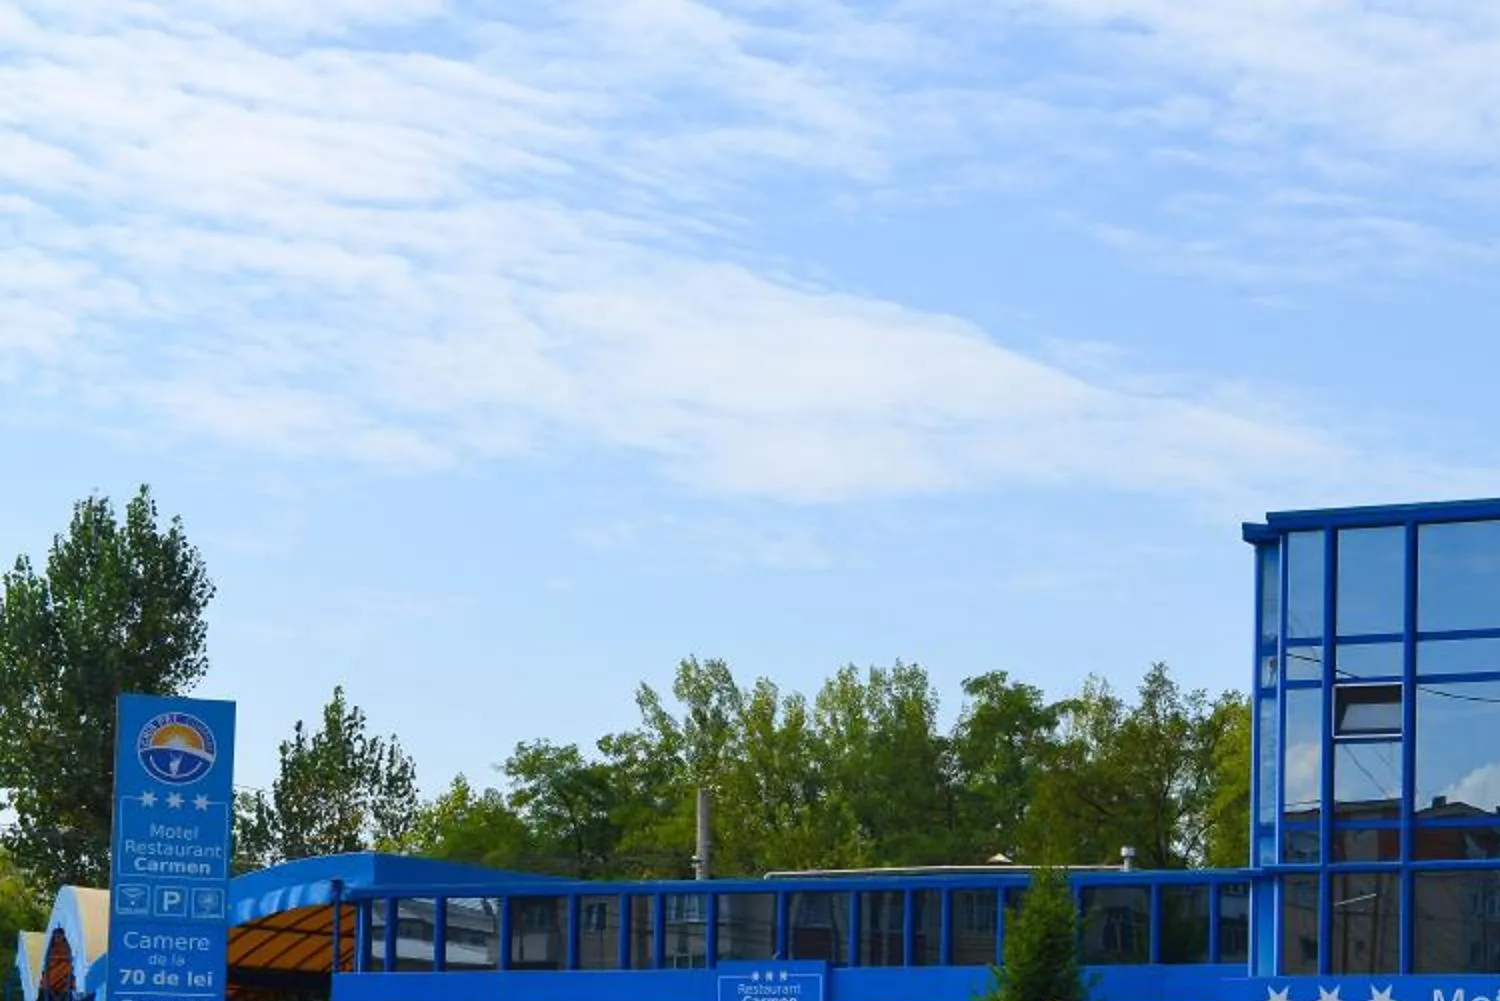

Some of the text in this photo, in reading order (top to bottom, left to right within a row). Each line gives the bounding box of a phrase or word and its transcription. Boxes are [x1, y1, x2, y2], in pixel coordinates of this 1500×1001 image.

[150, 822, 198, 840] Motel
[125, 839, 222, 859] Restaurant
[134, 857, 211, 875] Carmen
[163, 890, 180, 911] P
[123, 931, 210, 951] Camere
[149, 954, 186, 967] de la
[119, 969, 213, 987] 70 de lei
[738, 984, 801, 995] Restaurant
